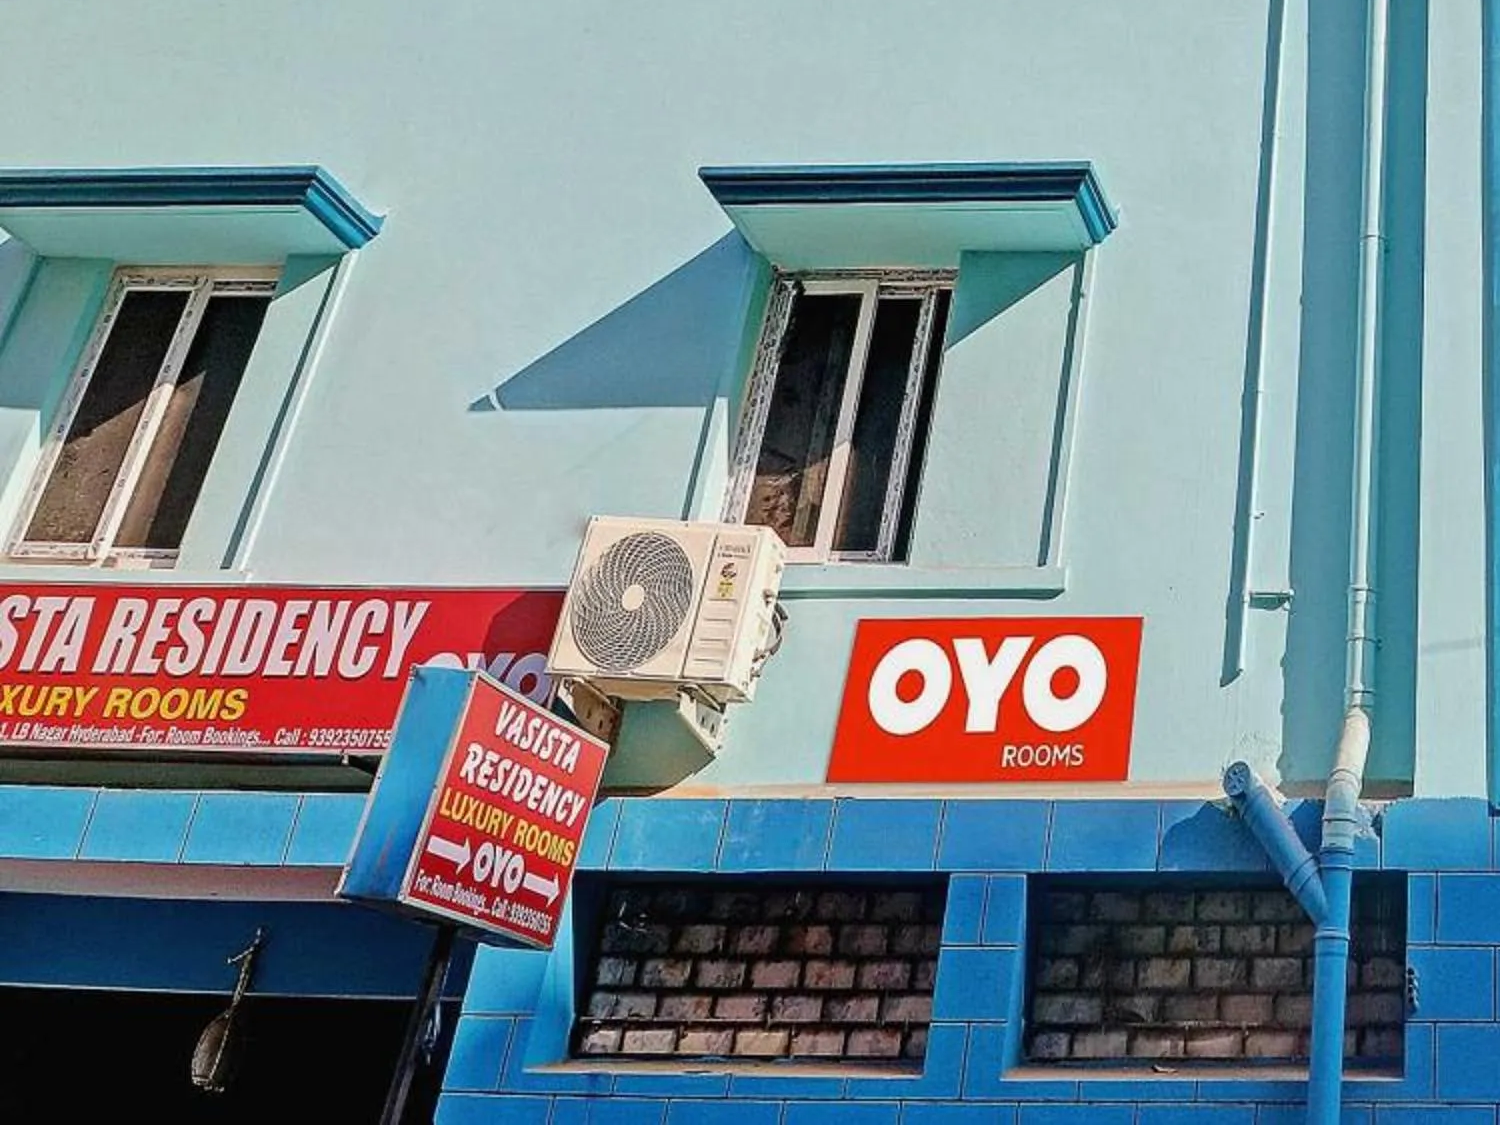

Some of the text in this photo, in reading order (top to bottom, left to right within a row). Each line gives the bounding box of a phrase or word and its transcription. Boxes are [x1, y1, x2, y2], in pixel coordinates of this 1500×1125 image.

[91, 597, 430, 679] RESIDENCY
[103, 686, 249, 721] ROOMS
[868, 634, 1108, 736] OYO
[11, 722, 31, 740] LB
[164, 726, 203, 745] Room
[495, 700, 582, 774] VASISTA
[1001, 744, 1085, 768] ROOMS
[459, 742, 587, 827] RESIDENCY
[439, 786, 575, 867] LUXURY ROOMS
[472, 841, 526, 894] OYO
